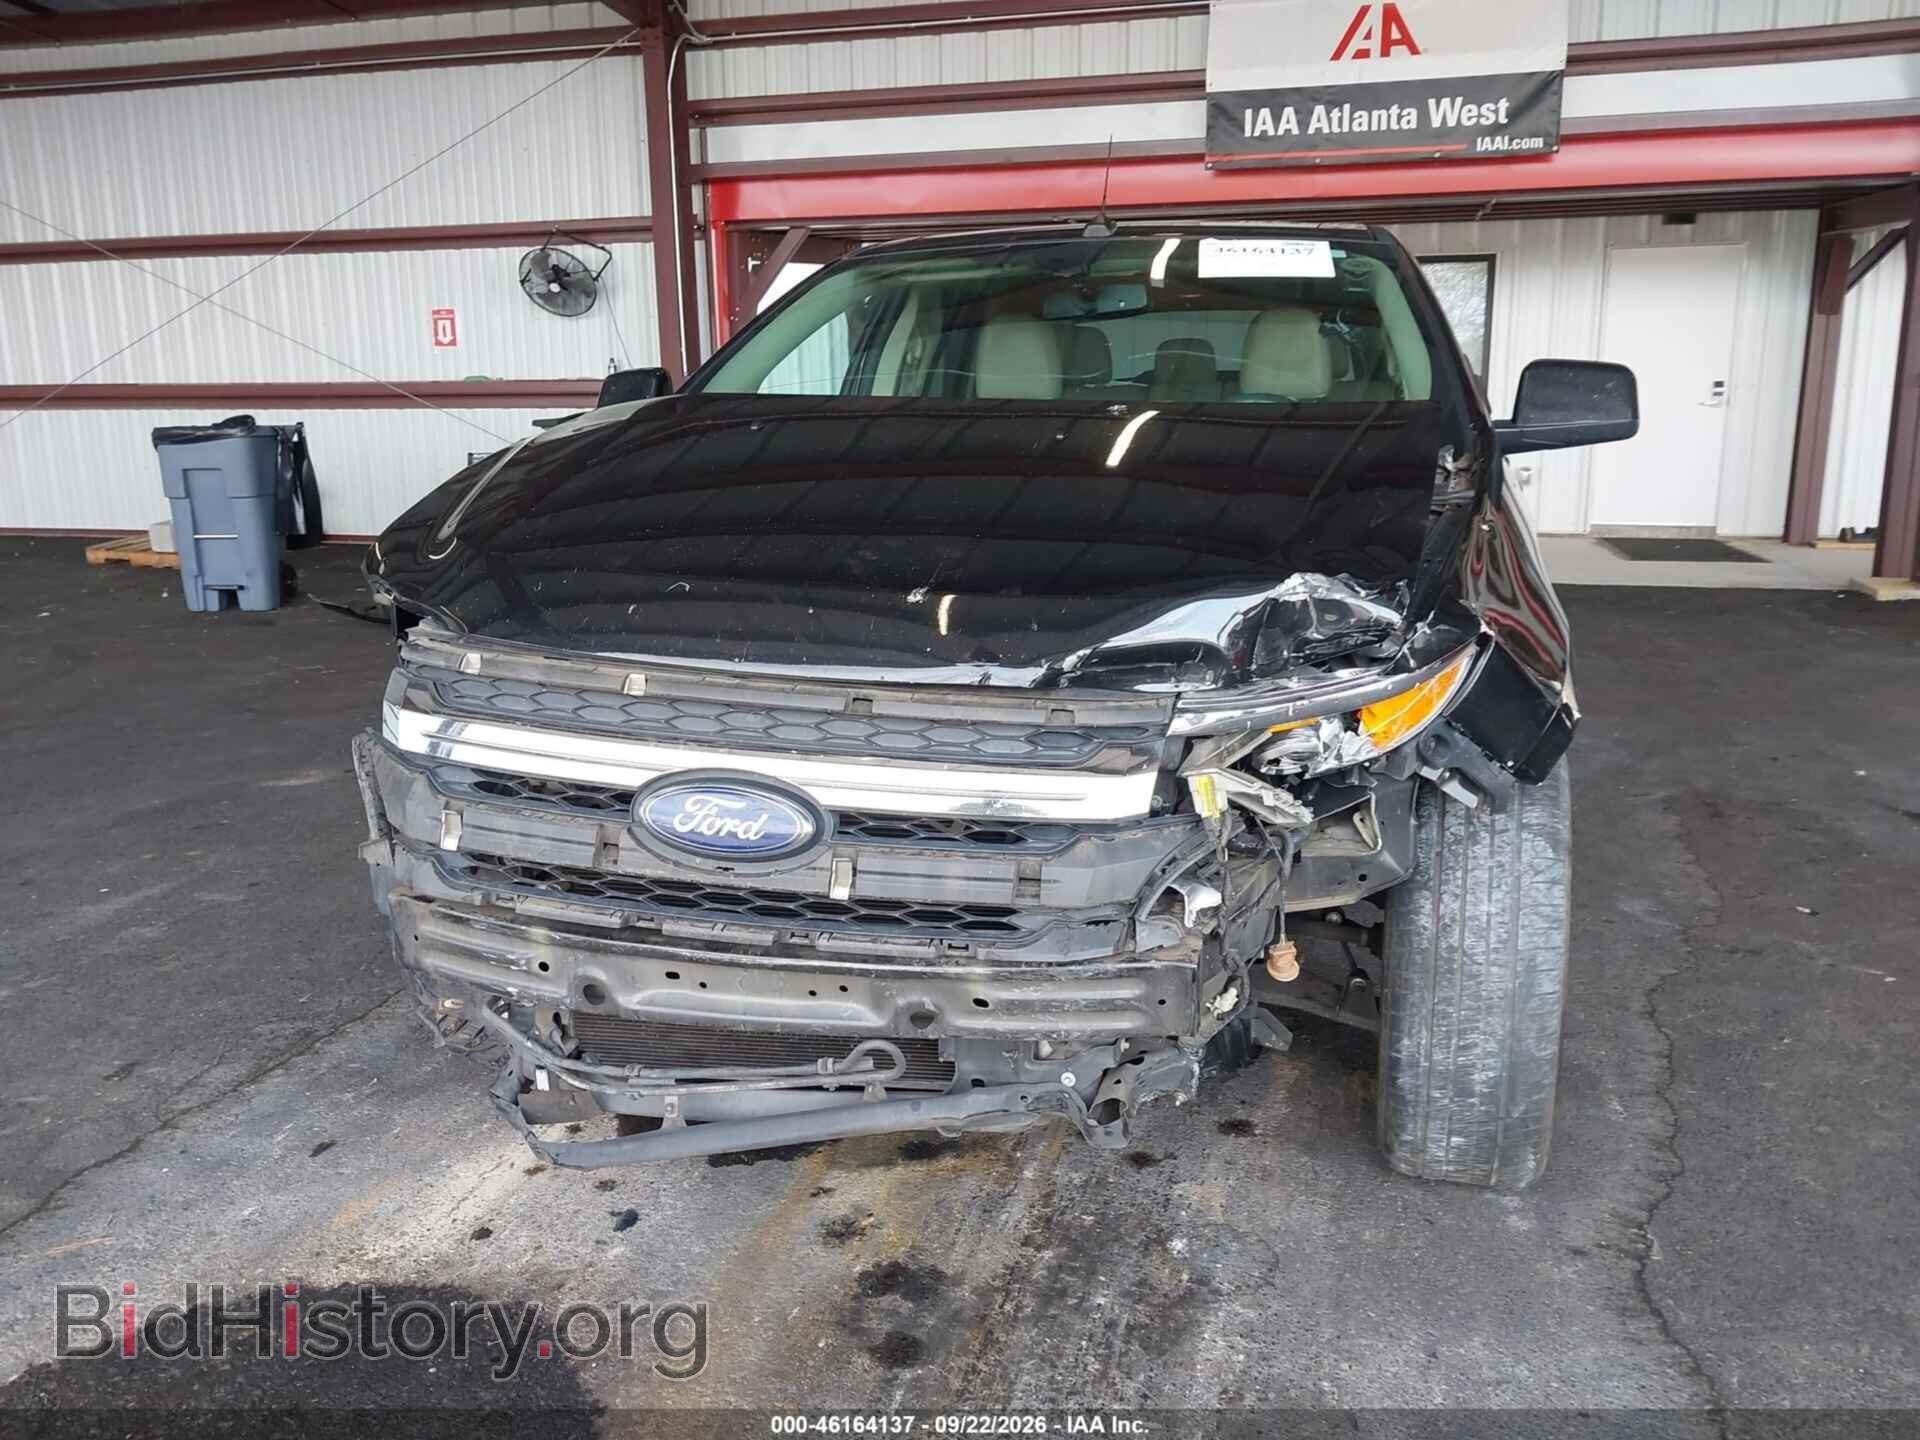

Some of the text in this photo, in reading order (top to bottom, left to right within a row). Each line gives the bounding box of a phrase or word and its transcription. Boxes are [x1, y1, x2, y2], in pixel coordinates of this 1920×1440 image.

[1244, 96, 1510, 137] IAA Atlanta West
[1476, 136, 1544, 152] IAAI.com
[673, 795, 770, 841] Ford
